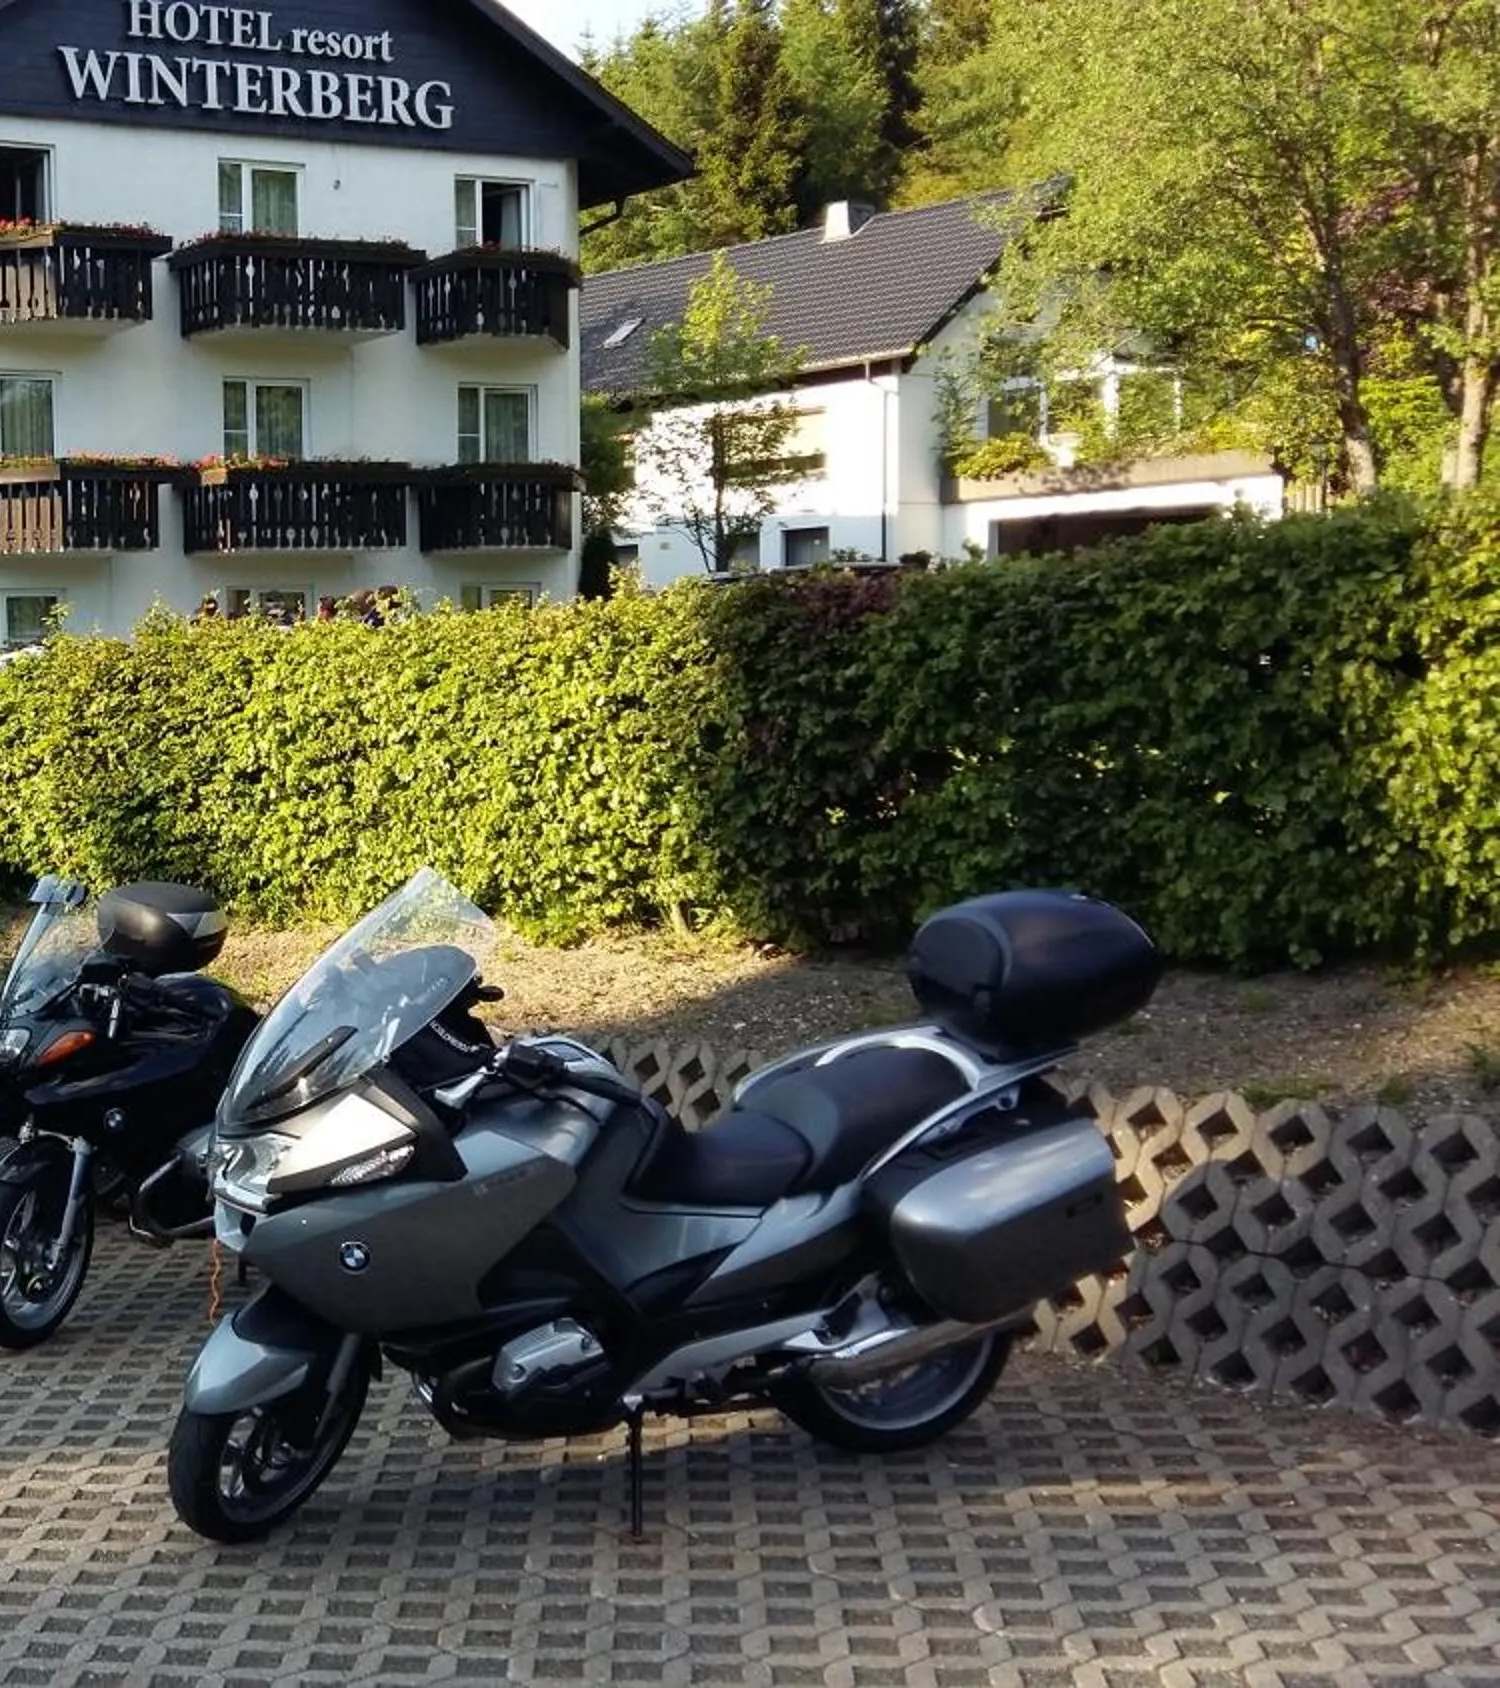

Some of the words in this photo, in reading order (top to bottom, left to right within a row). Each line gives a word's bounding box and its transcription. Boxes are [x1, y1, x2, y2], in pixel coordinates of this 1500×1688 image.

[127, 0, 282, 51] HOTEL
[291, 28, 394, 62] resort
[57, 45, 454, 130] WINTERBERG
